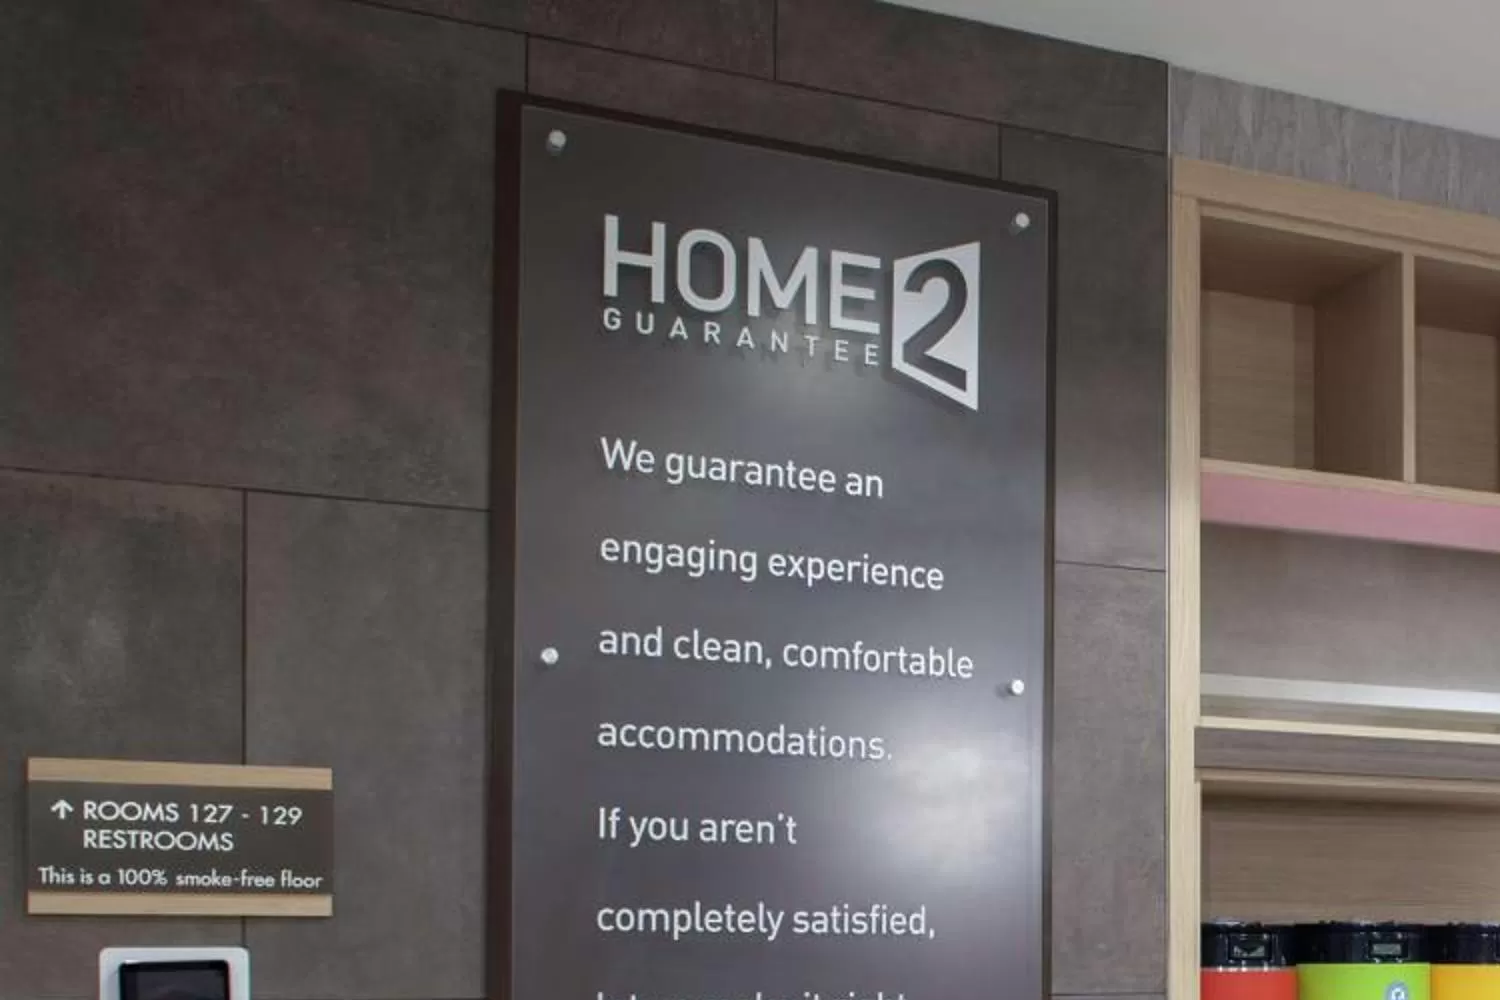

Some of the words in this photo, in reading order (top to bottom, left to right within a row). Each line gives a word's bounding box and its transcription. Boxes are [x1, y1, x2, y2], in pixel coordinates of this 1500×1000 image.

[603, 213, 882, 334] HOME
[903, 257, 969, 393] 2
[602, 307, 881, 366] GUARANTEE
[600, 436, 656, 473] We
[666, 453, 837, 493] guarantee
[844, 472, 884, 499] an
[600, 538, 758, 583] engaging
[767, 553, 945, 590] experience
[599, 626, 663, 657] and
[673, 628, 773, 669] clean,
[782, 641, 974, 679] comfortable
[598, 722, 893, 760] accommodations.
[83, 800, 180, 823] ROOMS
[190, 803, 234, 824] 127
[259, 806, 303, 825] 129
[599, 807, 620, 840] If
[629, 815, 689, 848] you
[698, 812, 798, 845] aren't
[83, 829, 235, 852] RESTROOMS
[38, 866, 75, 886] This
[79, 867, 94, 886] is
[98, 872, 111, 886] a
[118, 868, 168, 887] 100%
[175, 868, 275, 889] smoke-free
[280, 870, 323, 889] floor
[597, 900, 785, 941] completely
[792, 903, 936, 939] satisfied,
